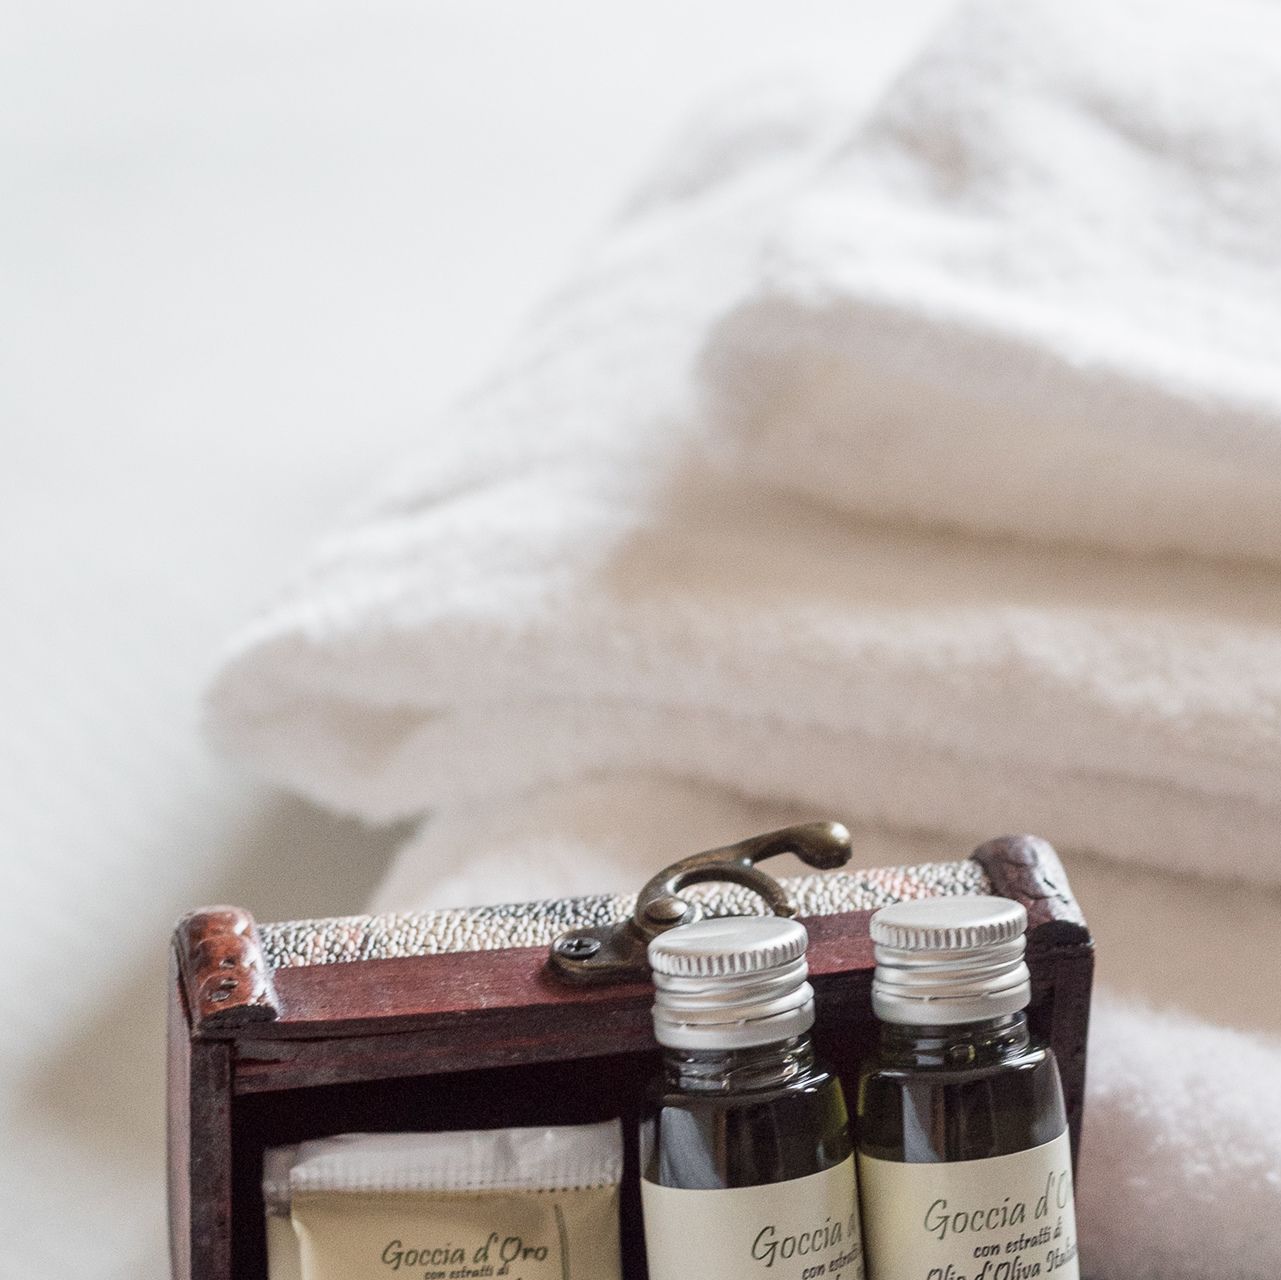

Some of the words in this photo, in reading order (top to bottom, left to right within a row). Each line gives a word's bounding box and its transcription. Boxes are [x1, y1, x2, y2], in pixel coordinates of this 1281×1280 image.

[924, 1196, 1027, 1241] Goccia
[1034, 1170, 1069, 1220] d'O
[381, 1238, 466, 1270] Goccia
[473, 1231, 550, 1265] d'Oro
[751, 1216, 843, 1268] Goccia
[973, 1243, 1001, 1259] con
[1005, 1225, 1052, 1255] estratti
[424, 1270, 447, 1280] con
[450, 1266, 495, 1280] estratti
[497, 1264, 510, 1277] di
[801, 1264, 826, 1280] con
